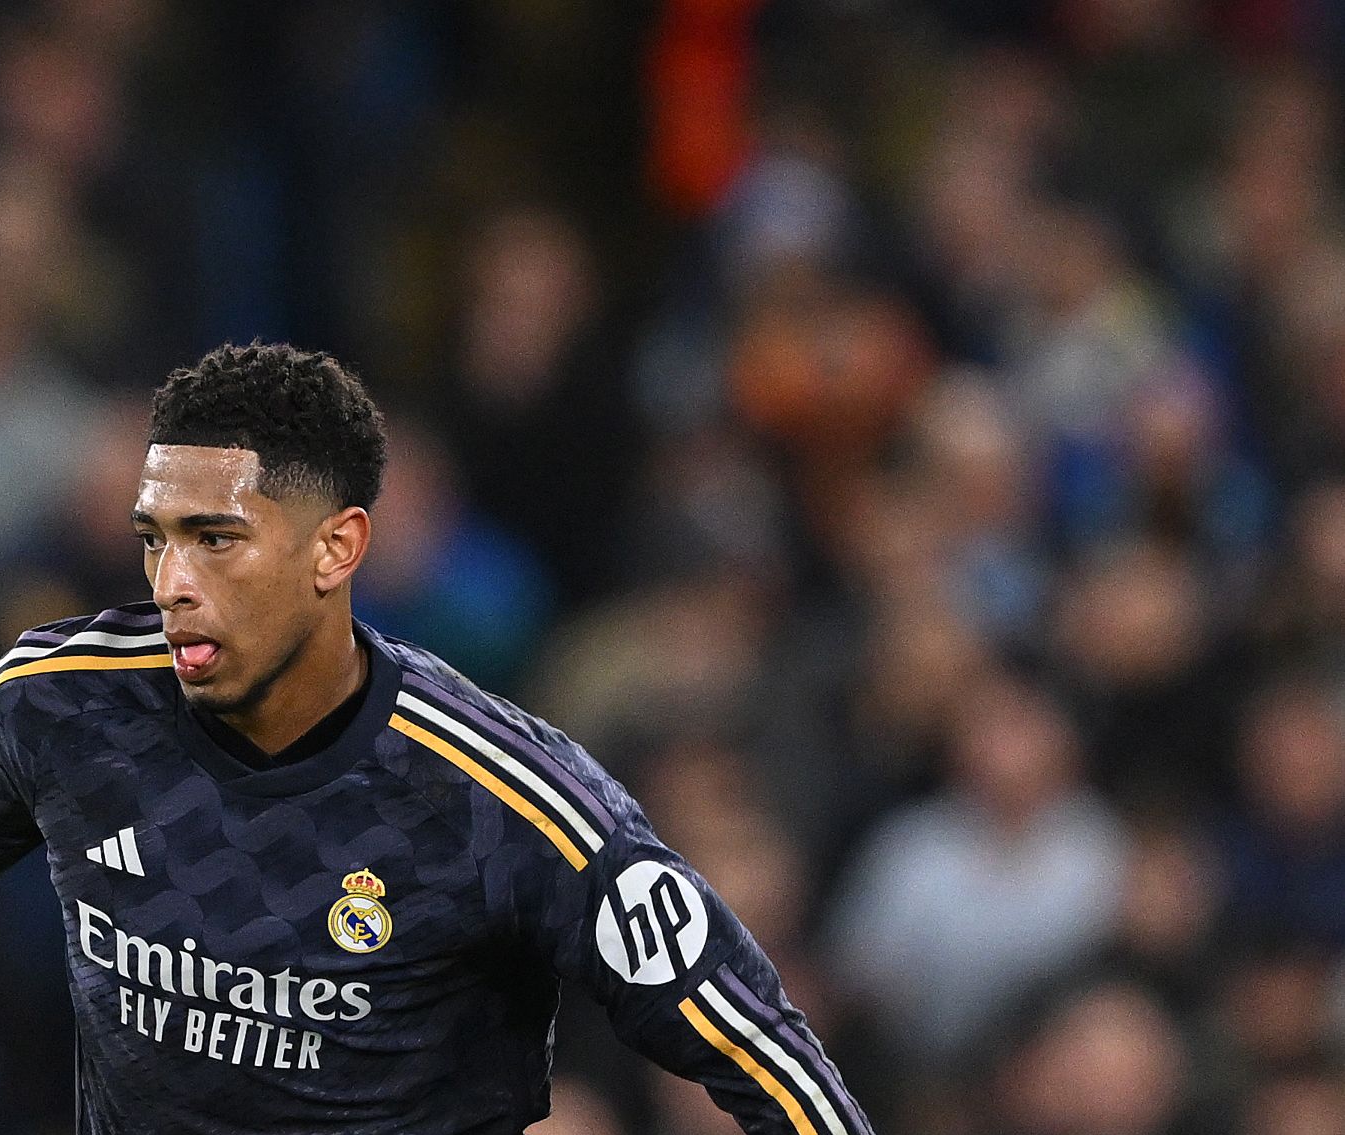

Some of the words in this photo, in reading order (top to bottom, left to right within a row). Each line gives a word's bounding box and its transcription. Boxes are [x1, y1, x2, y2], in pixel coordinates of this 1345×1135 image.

[76, 899, 372, 1021] Emirates
[605, 871, 691, 980] hp
[119, 986, 171, 1043] FLY
[183, 1008, 323, 1069] BETTER
